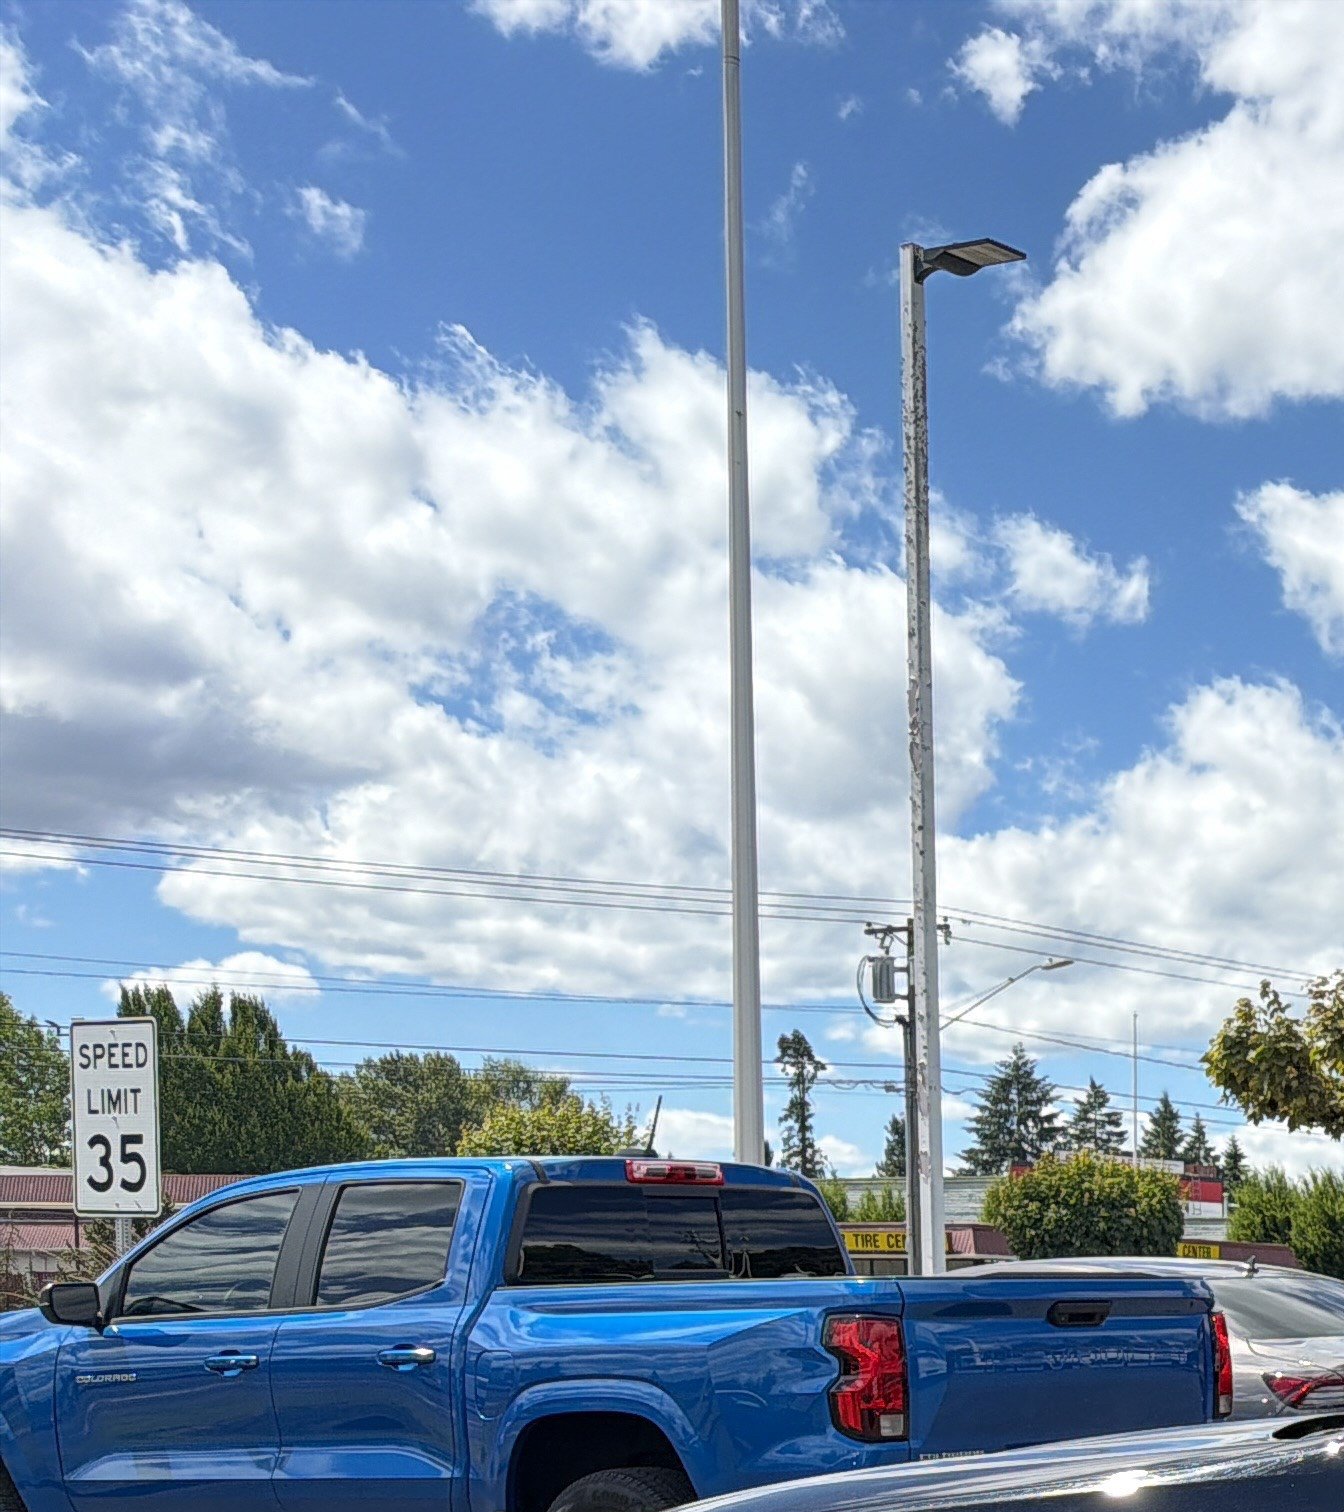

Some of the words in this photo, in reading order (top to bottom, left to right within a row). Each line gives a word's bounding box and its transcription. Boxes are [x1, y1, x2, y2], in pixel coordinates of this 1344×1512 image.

[79, 1042, 148, 1069] SPEED
[87, 1088, 142, 1115] LIMIT
[86, 1133, 147, 1193] 35
[852, 1233, 880, 1249] TIRE
